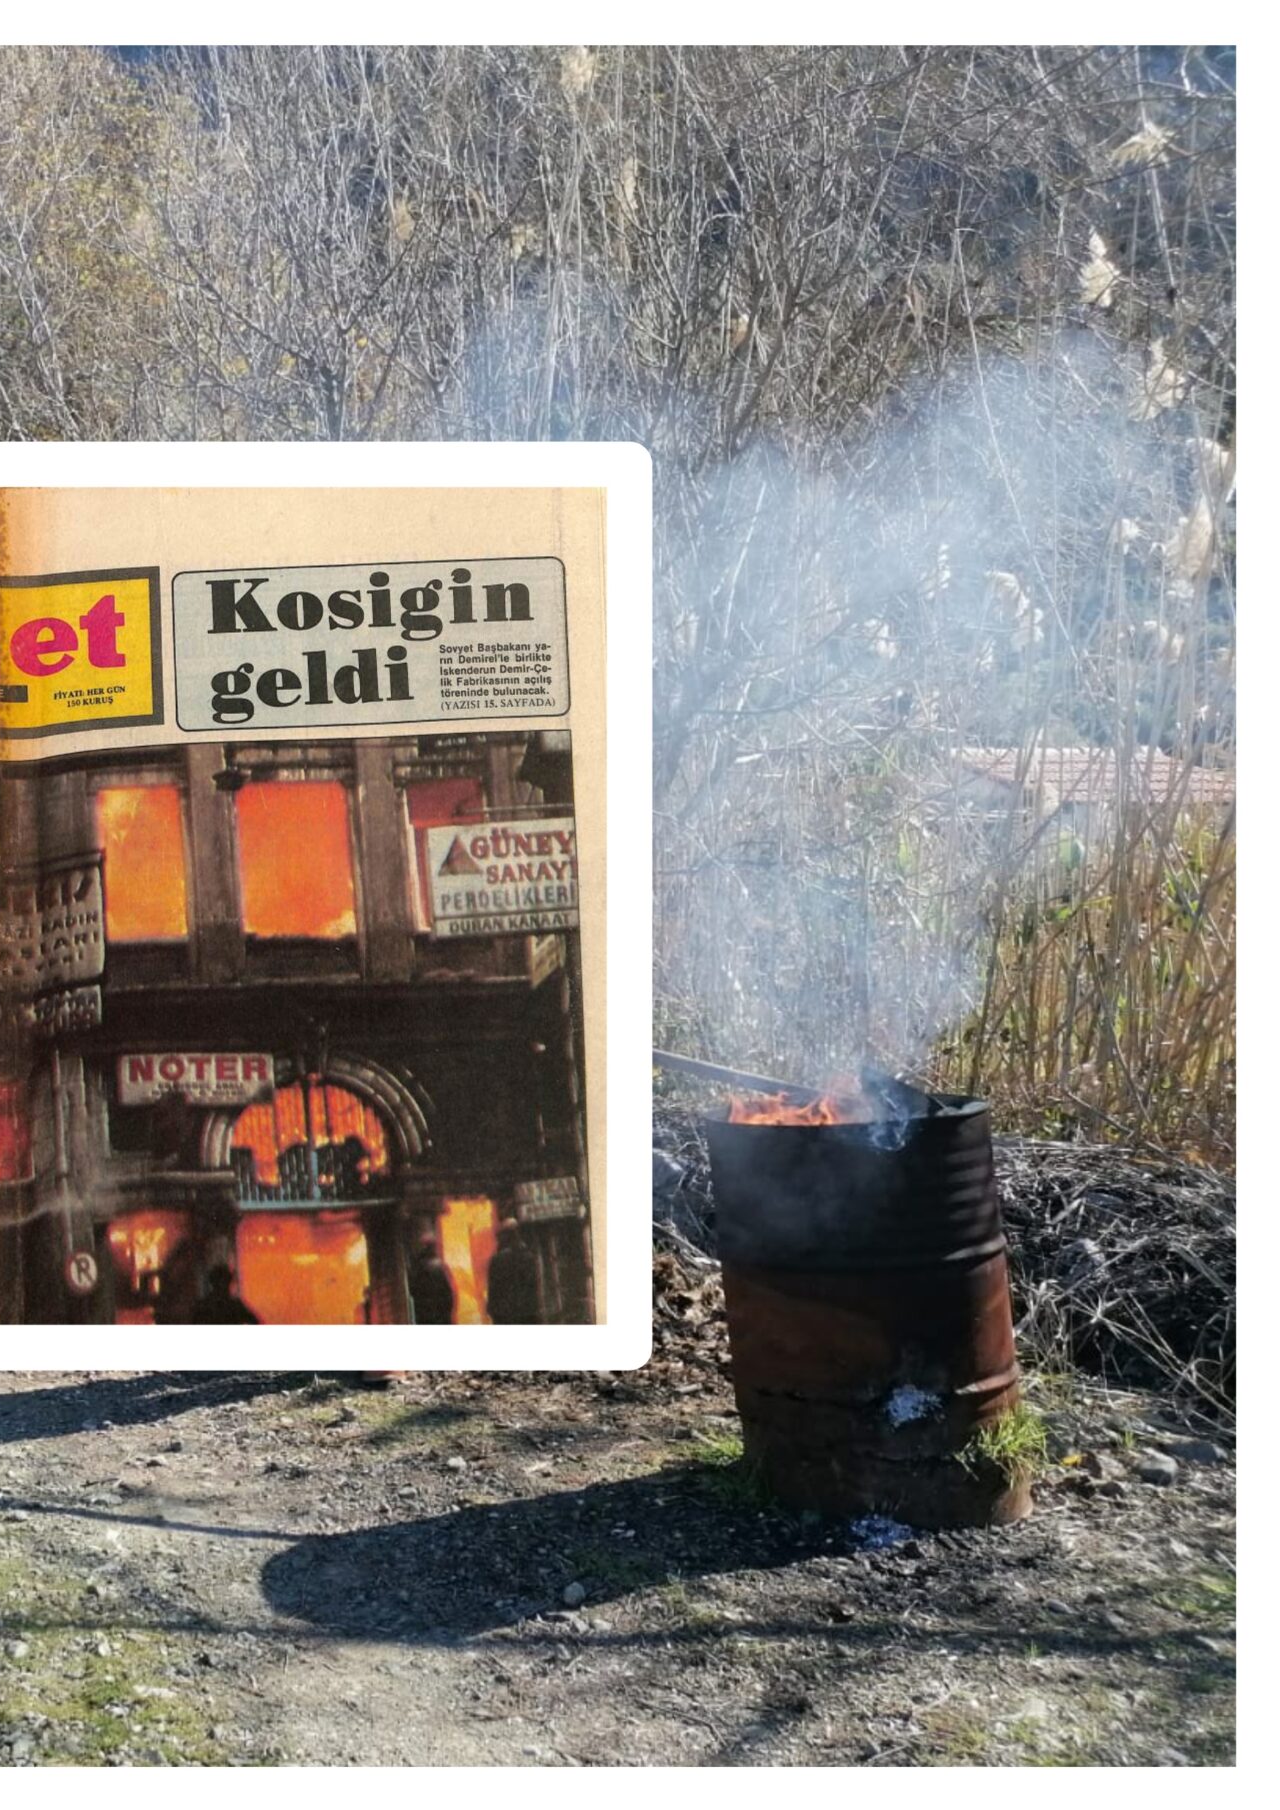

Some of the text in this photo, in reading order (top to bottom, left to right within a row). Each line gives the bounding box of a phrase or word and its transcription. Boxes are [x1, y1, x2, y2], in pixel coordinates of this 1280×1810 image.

[206, 567, 534, 641] Kosigin
[439, 643, 551, 654] Sovyet Başbakanı ya-
[458, 654, 510, 664] Demirel'le
[515, 653, 552, 662] birlikte
[499, 664, 552, 674] Demir-Çe-
[210, 645, 414, 724] geldi
[440, 675, 552, 686] lik Fabrikasının açılış
[87, 688, 105, 696] HER
[107, 685, 125, 694] GÜN
[440, 686, 549, 698] töreninde bulunacak.
[67, 696, 114, 708] 150 KURUŞ
[484, 700, 498, 708] 15.
[500, 698, 556, 708] SAYFADA)
[471, 828, 576, 859] GÜNEY
[129, 1055, 267, 1082] NOTER
